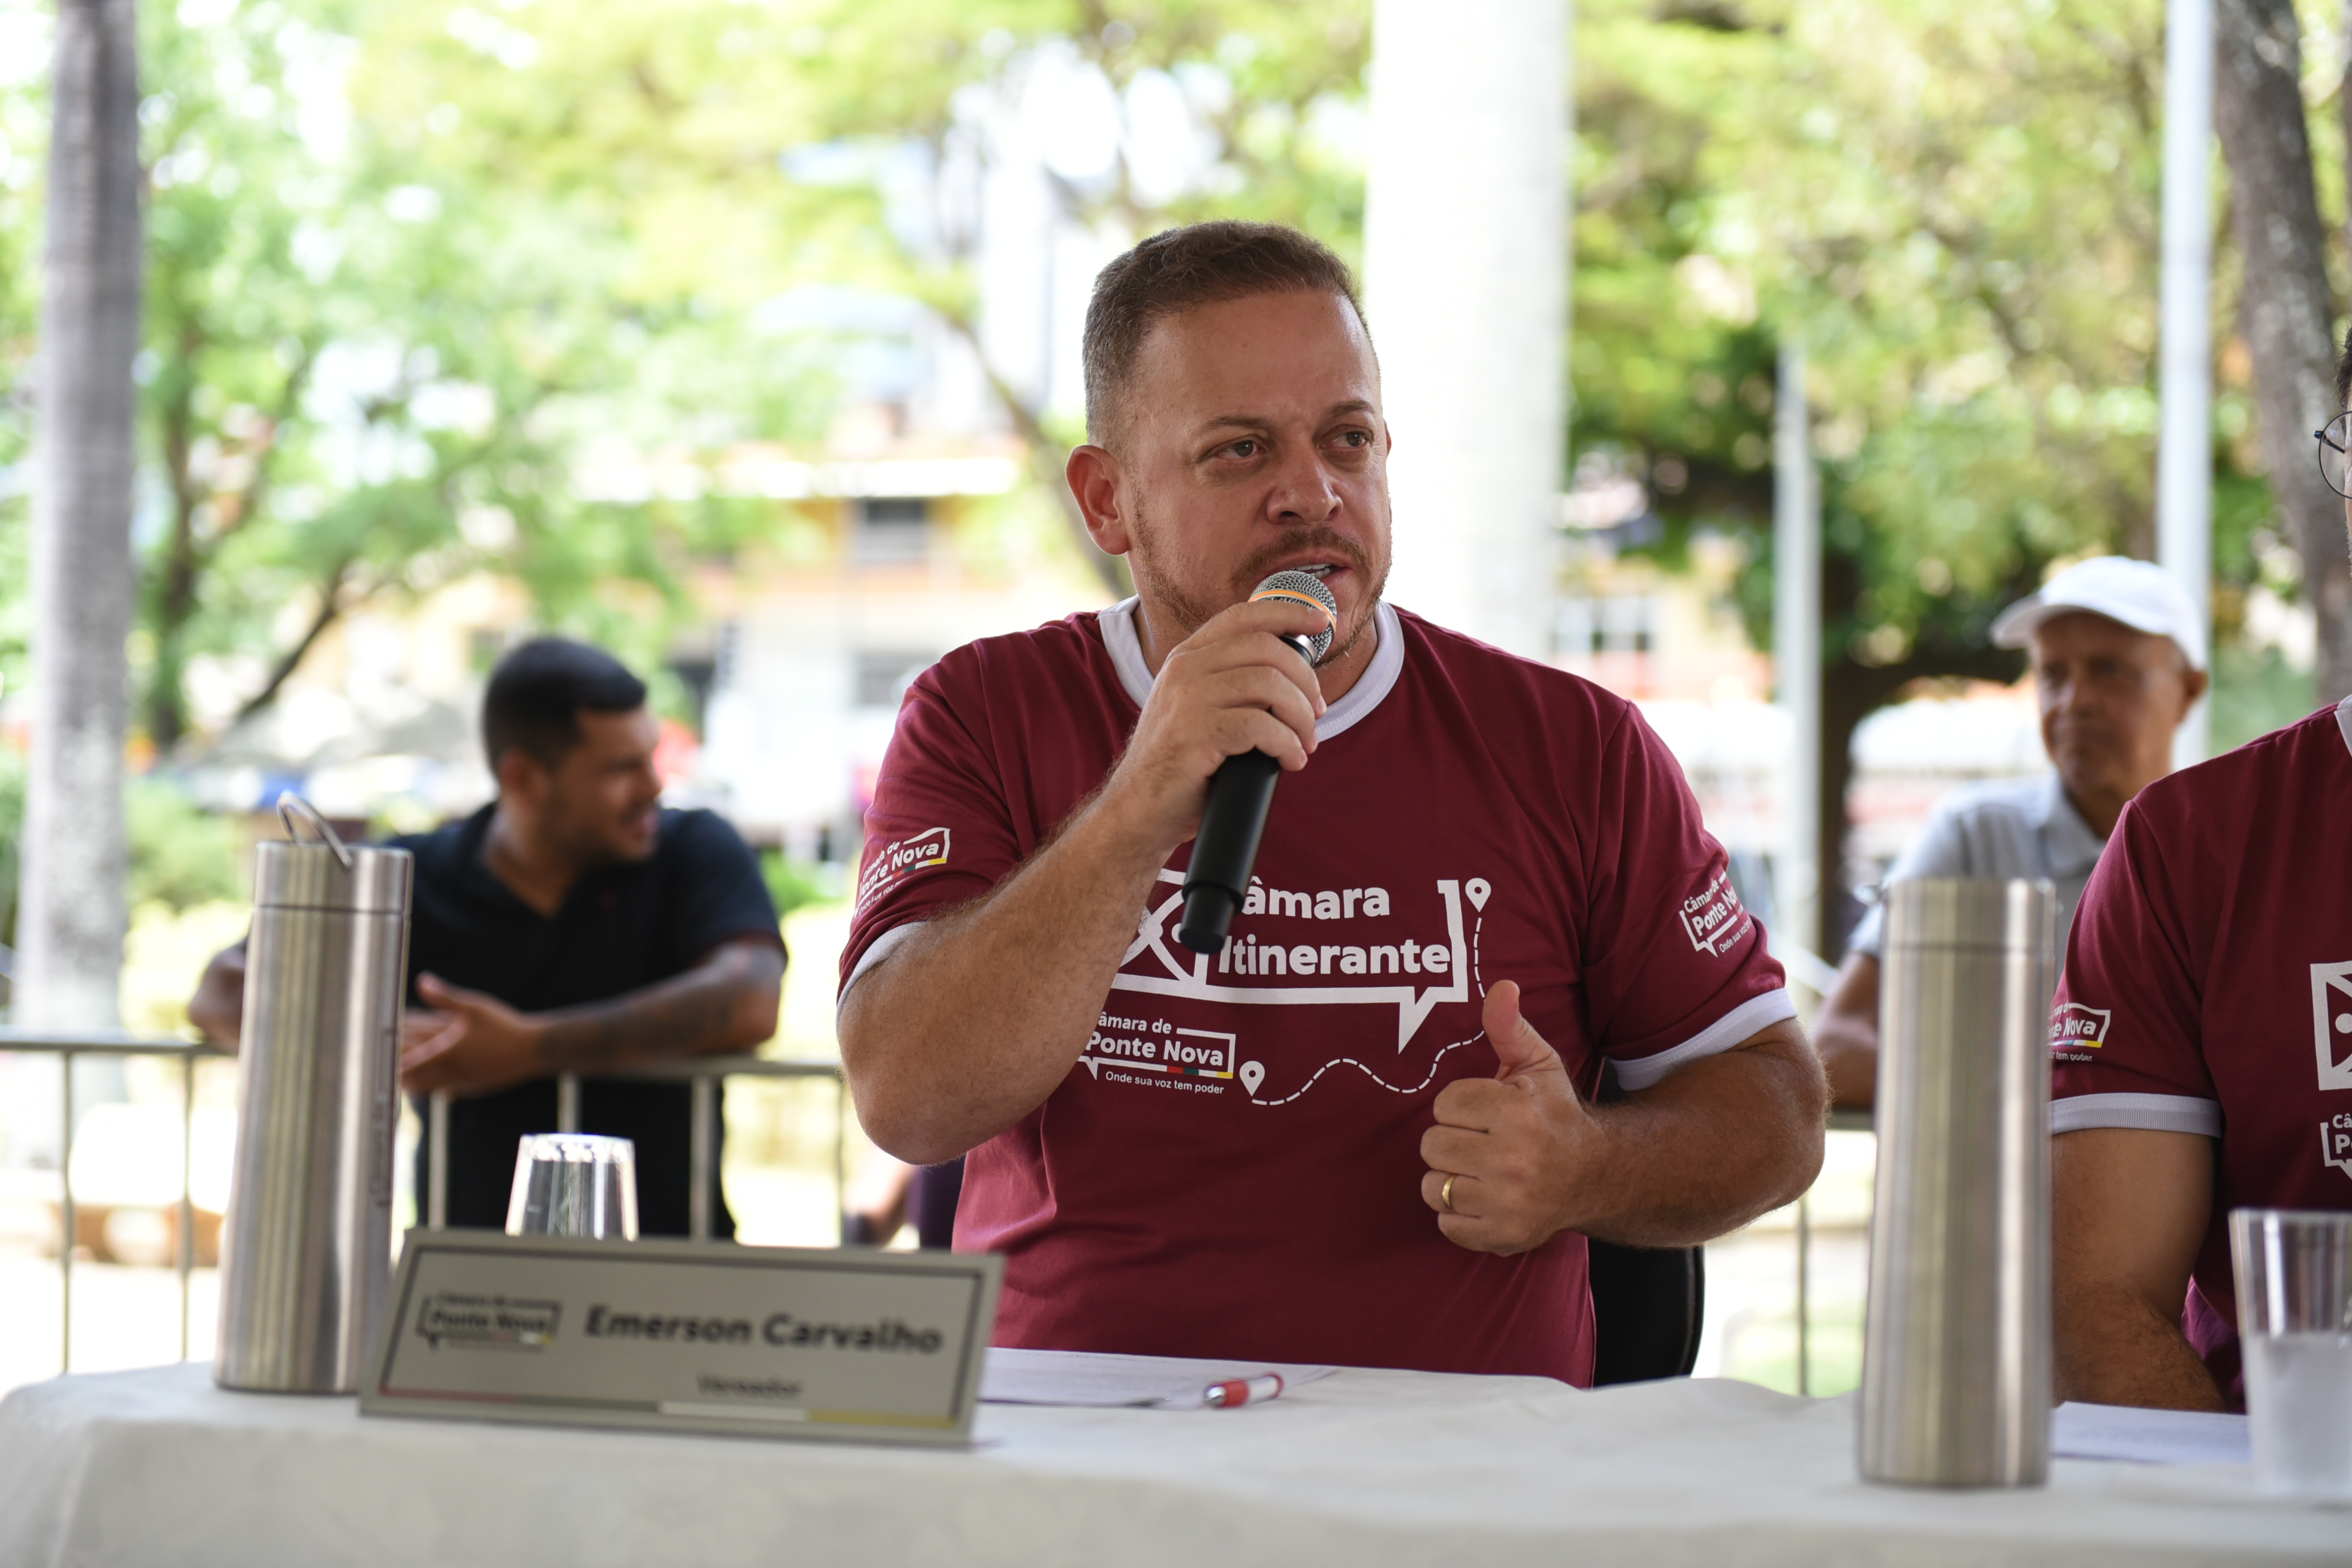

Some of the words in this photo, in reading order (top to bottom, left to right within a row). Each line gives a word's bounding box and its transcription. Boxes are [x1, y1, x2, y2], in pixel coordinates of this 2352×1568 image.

[887, 841, 900, 855] de
[891, 843, 939, 871] Nova
[1241, 875, 1390, 920] âmara
[1692, 902, 1728, 937] Ponte
[1719, 938, 1734, 953] Onde
[1732, 931, 1742, 942] sua
[1219, 933, 1451, 975] Itinerante
[1098, 1011, 1147, 1032] âmara
[1152, 1018, 1172, 1034] de
[2063, 1016, 2097, 1037] Nova
[1085, 1031, 1156, 1058] Ponte
[1163, 1039, 1223, 1066] Nova
[2056, 1051, 2069, 1060] tem
[2070, 1053, 2093, 1062] poder
[1106, 1071, 1132, 1083] Onde
[1135, 1075, 1152, 1086] sua
[1155, 1079, 1172, 1088] voz
[1174, 1080, 1193, 1091] tem
[1195, 1084, 1224, 1094] poder
[2335, 1134, 2352, 1154] P
[584, 1303, 754, 1343] Emerson
[761, 1312, 944, 1355] Carvalho
